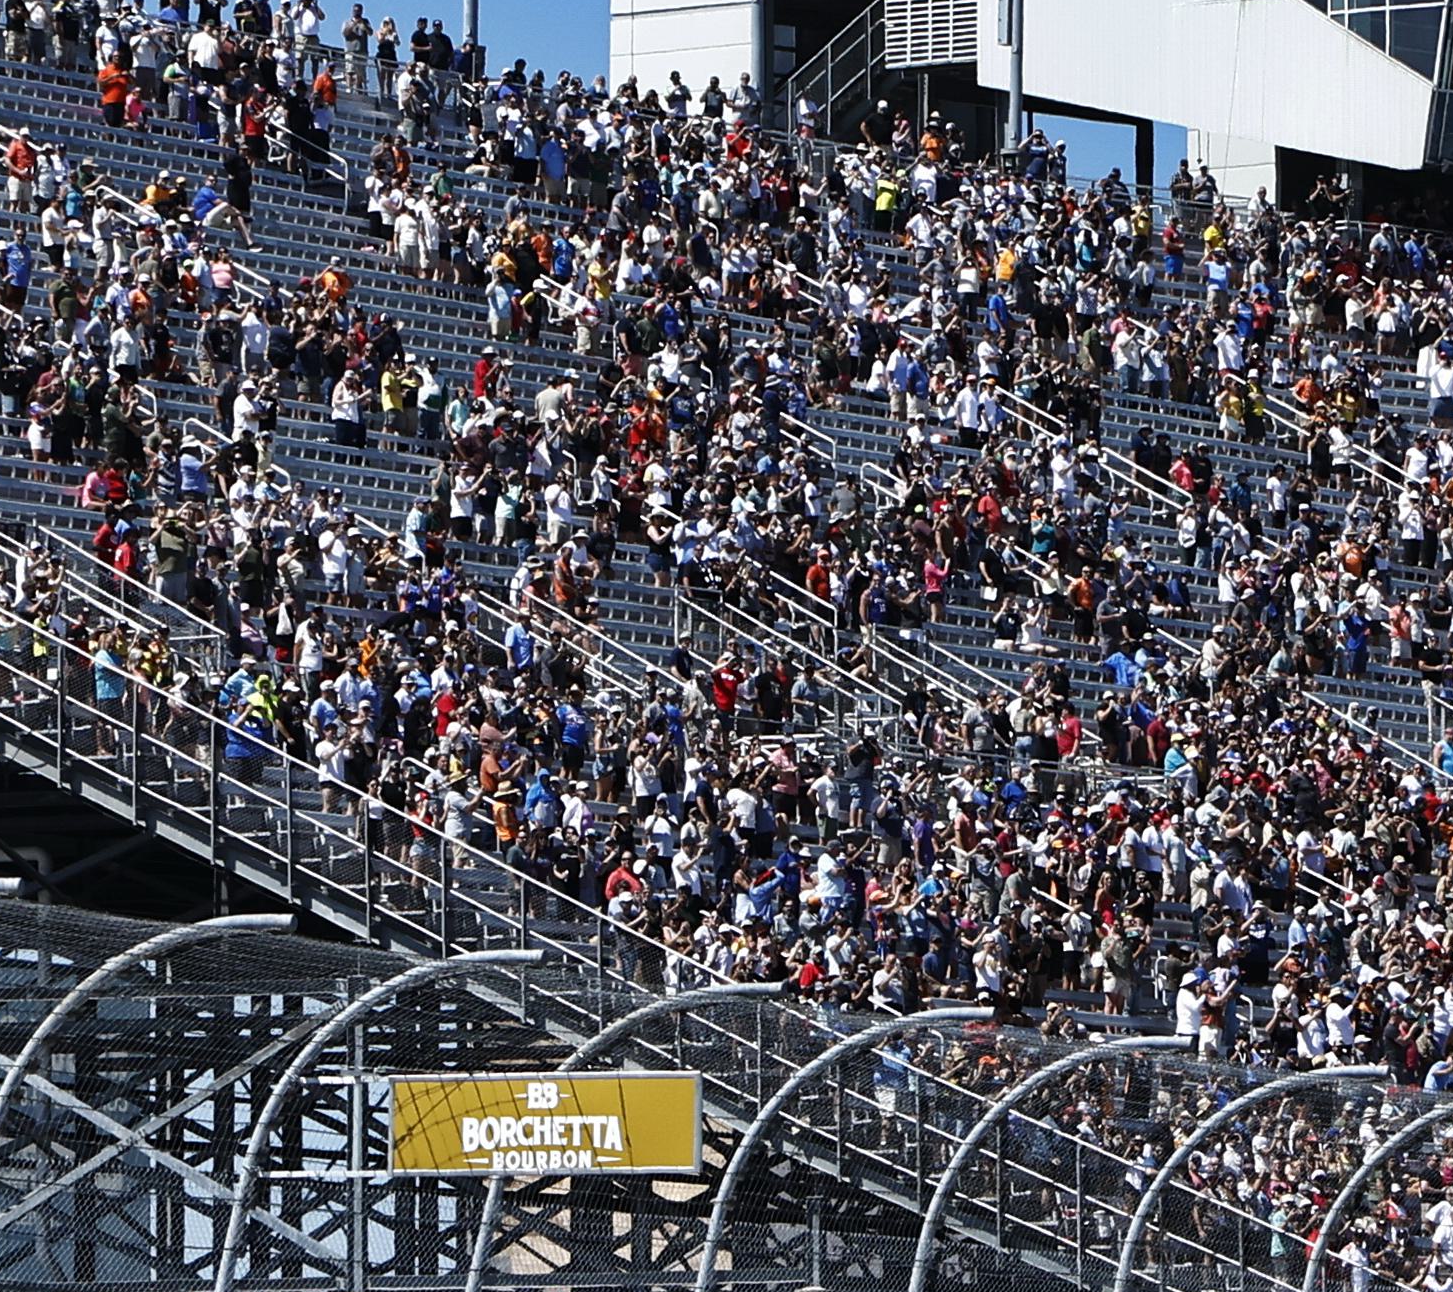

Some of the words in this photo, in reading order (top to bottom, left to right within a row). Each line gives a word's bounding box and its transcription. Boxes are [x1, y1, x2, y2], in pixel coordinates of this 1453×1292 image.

[527, 1082, 559, 1109] BB
[462, 1115, 623, 1152] BORCHETTA
[492, 1149, 592, 1170] BOURBON
